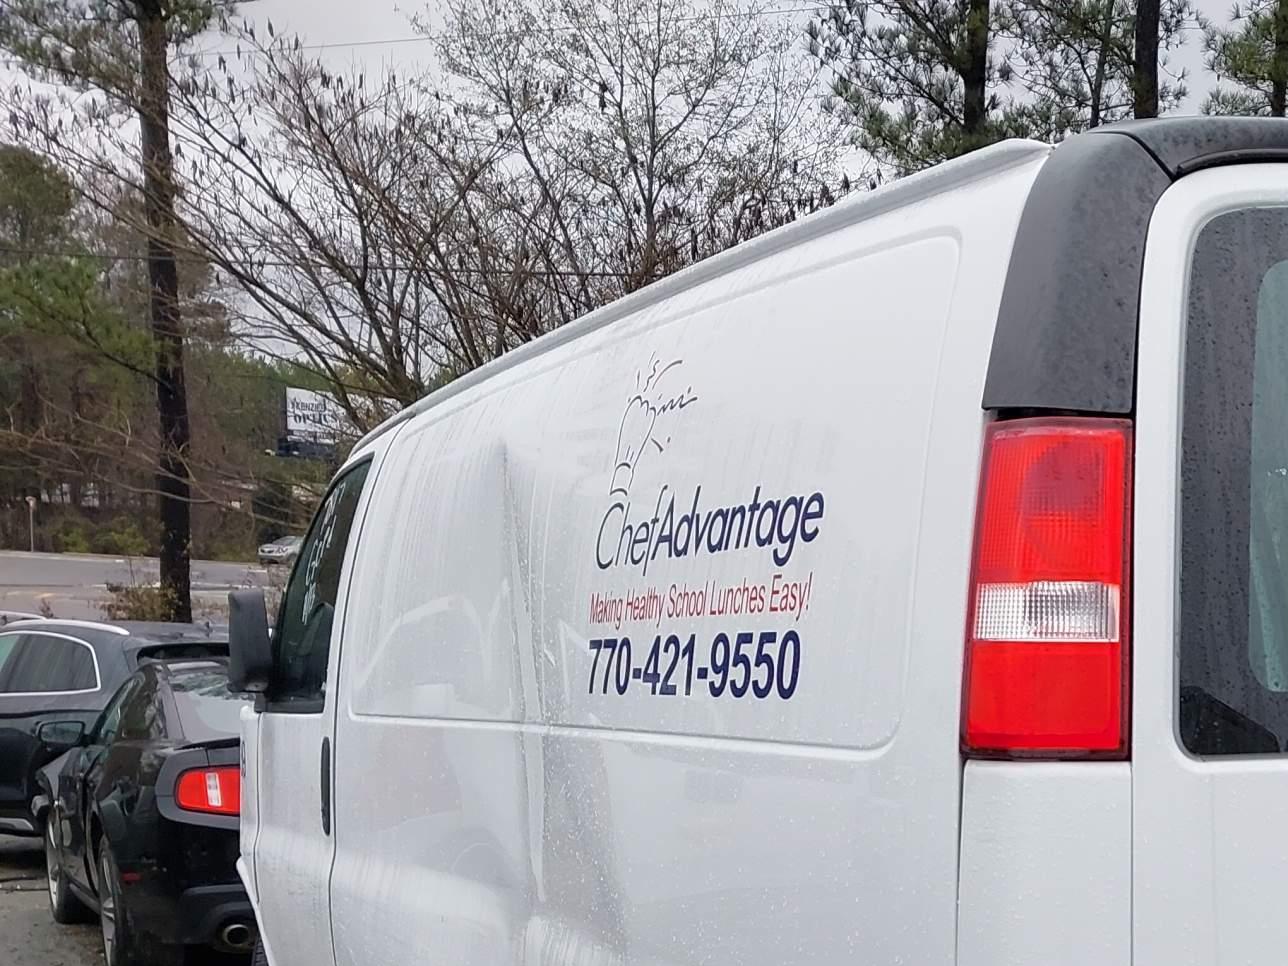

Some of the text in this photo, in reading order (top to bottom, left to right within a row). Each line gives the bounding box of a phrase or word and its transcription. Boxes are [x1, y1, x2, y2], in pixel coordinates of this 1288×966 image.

[596, 485, 825, 577] ChefAdvantage
[589, 572, 813, 630] Making Healthy School Lunches Easy!
[588, 629, 801, 700] 770-421-9550
